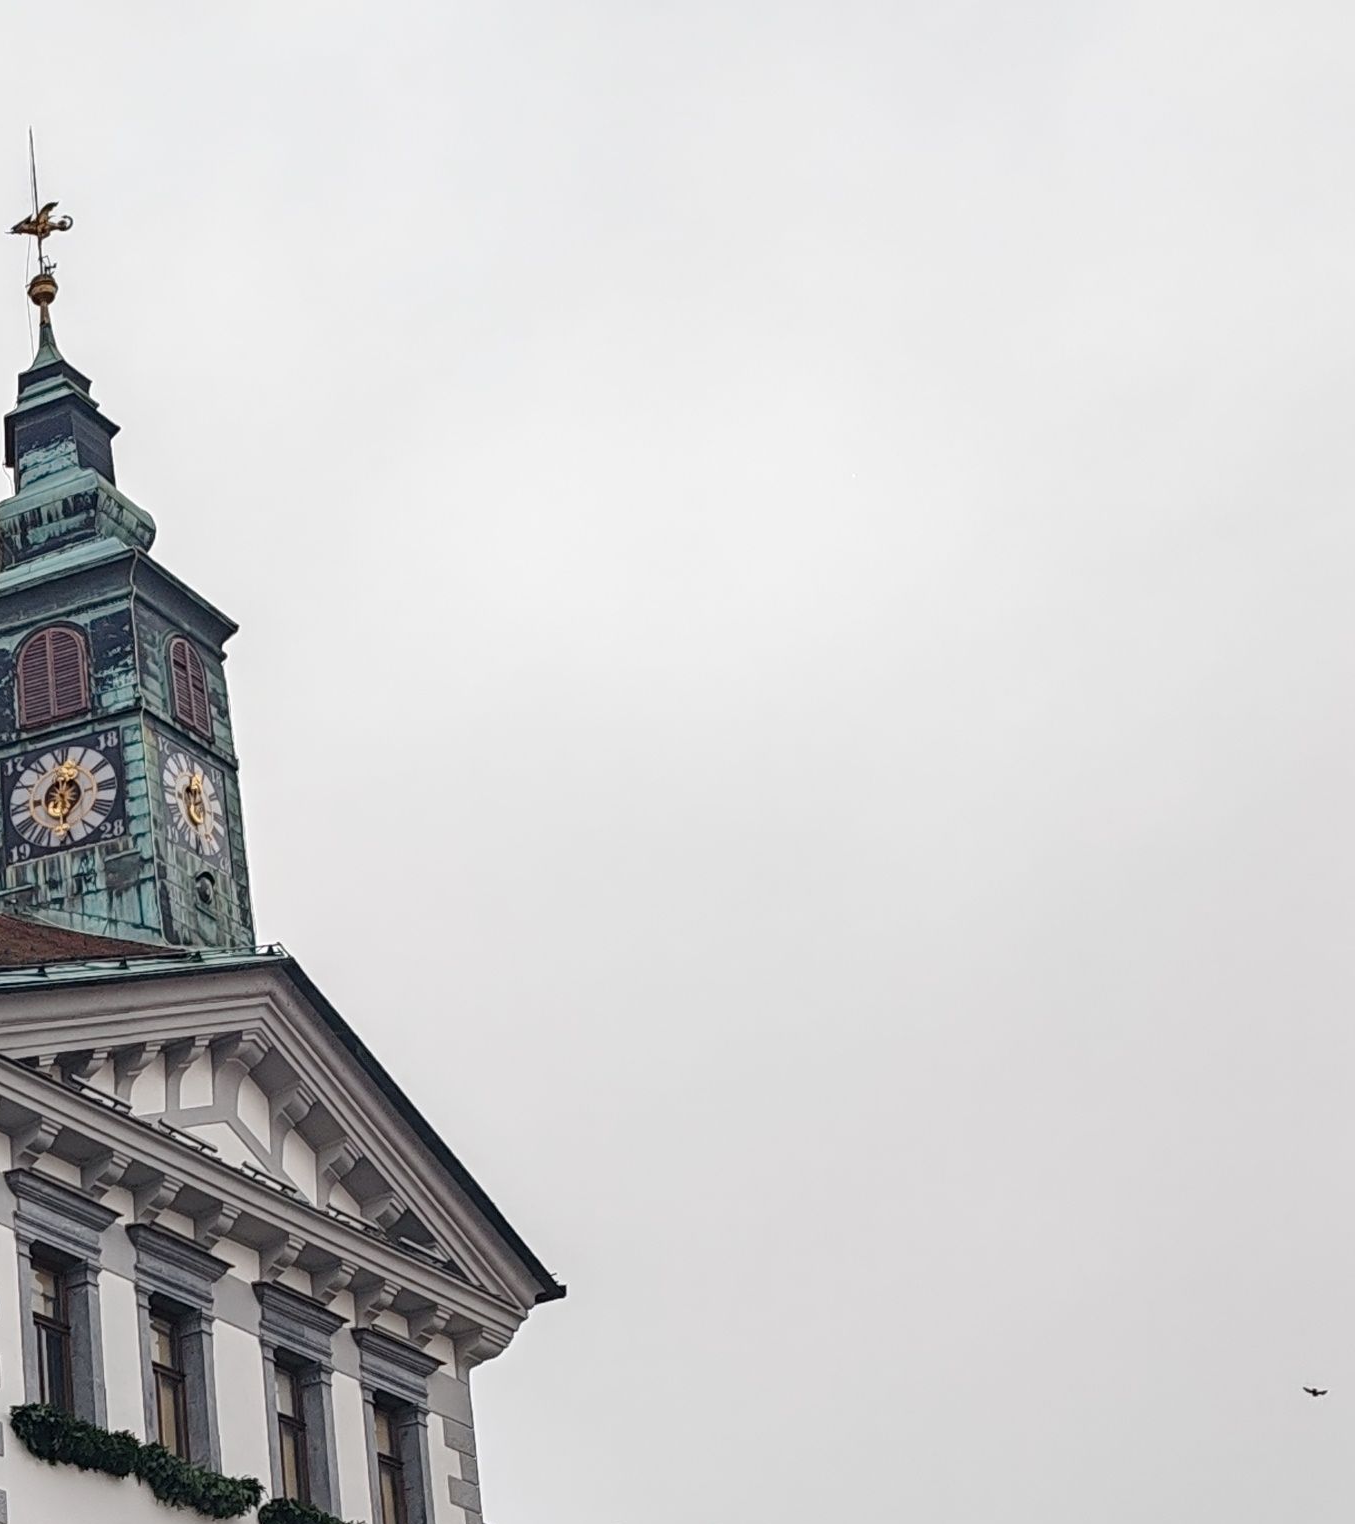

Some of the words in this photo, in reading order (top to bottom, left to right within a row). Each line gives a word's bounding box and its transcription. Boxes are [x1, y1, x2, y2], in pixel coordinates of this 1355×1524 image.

[96, 730, 118, 751] 18
[100, 819, 124, 838] 28
[11, 843, 30, 862] 19
